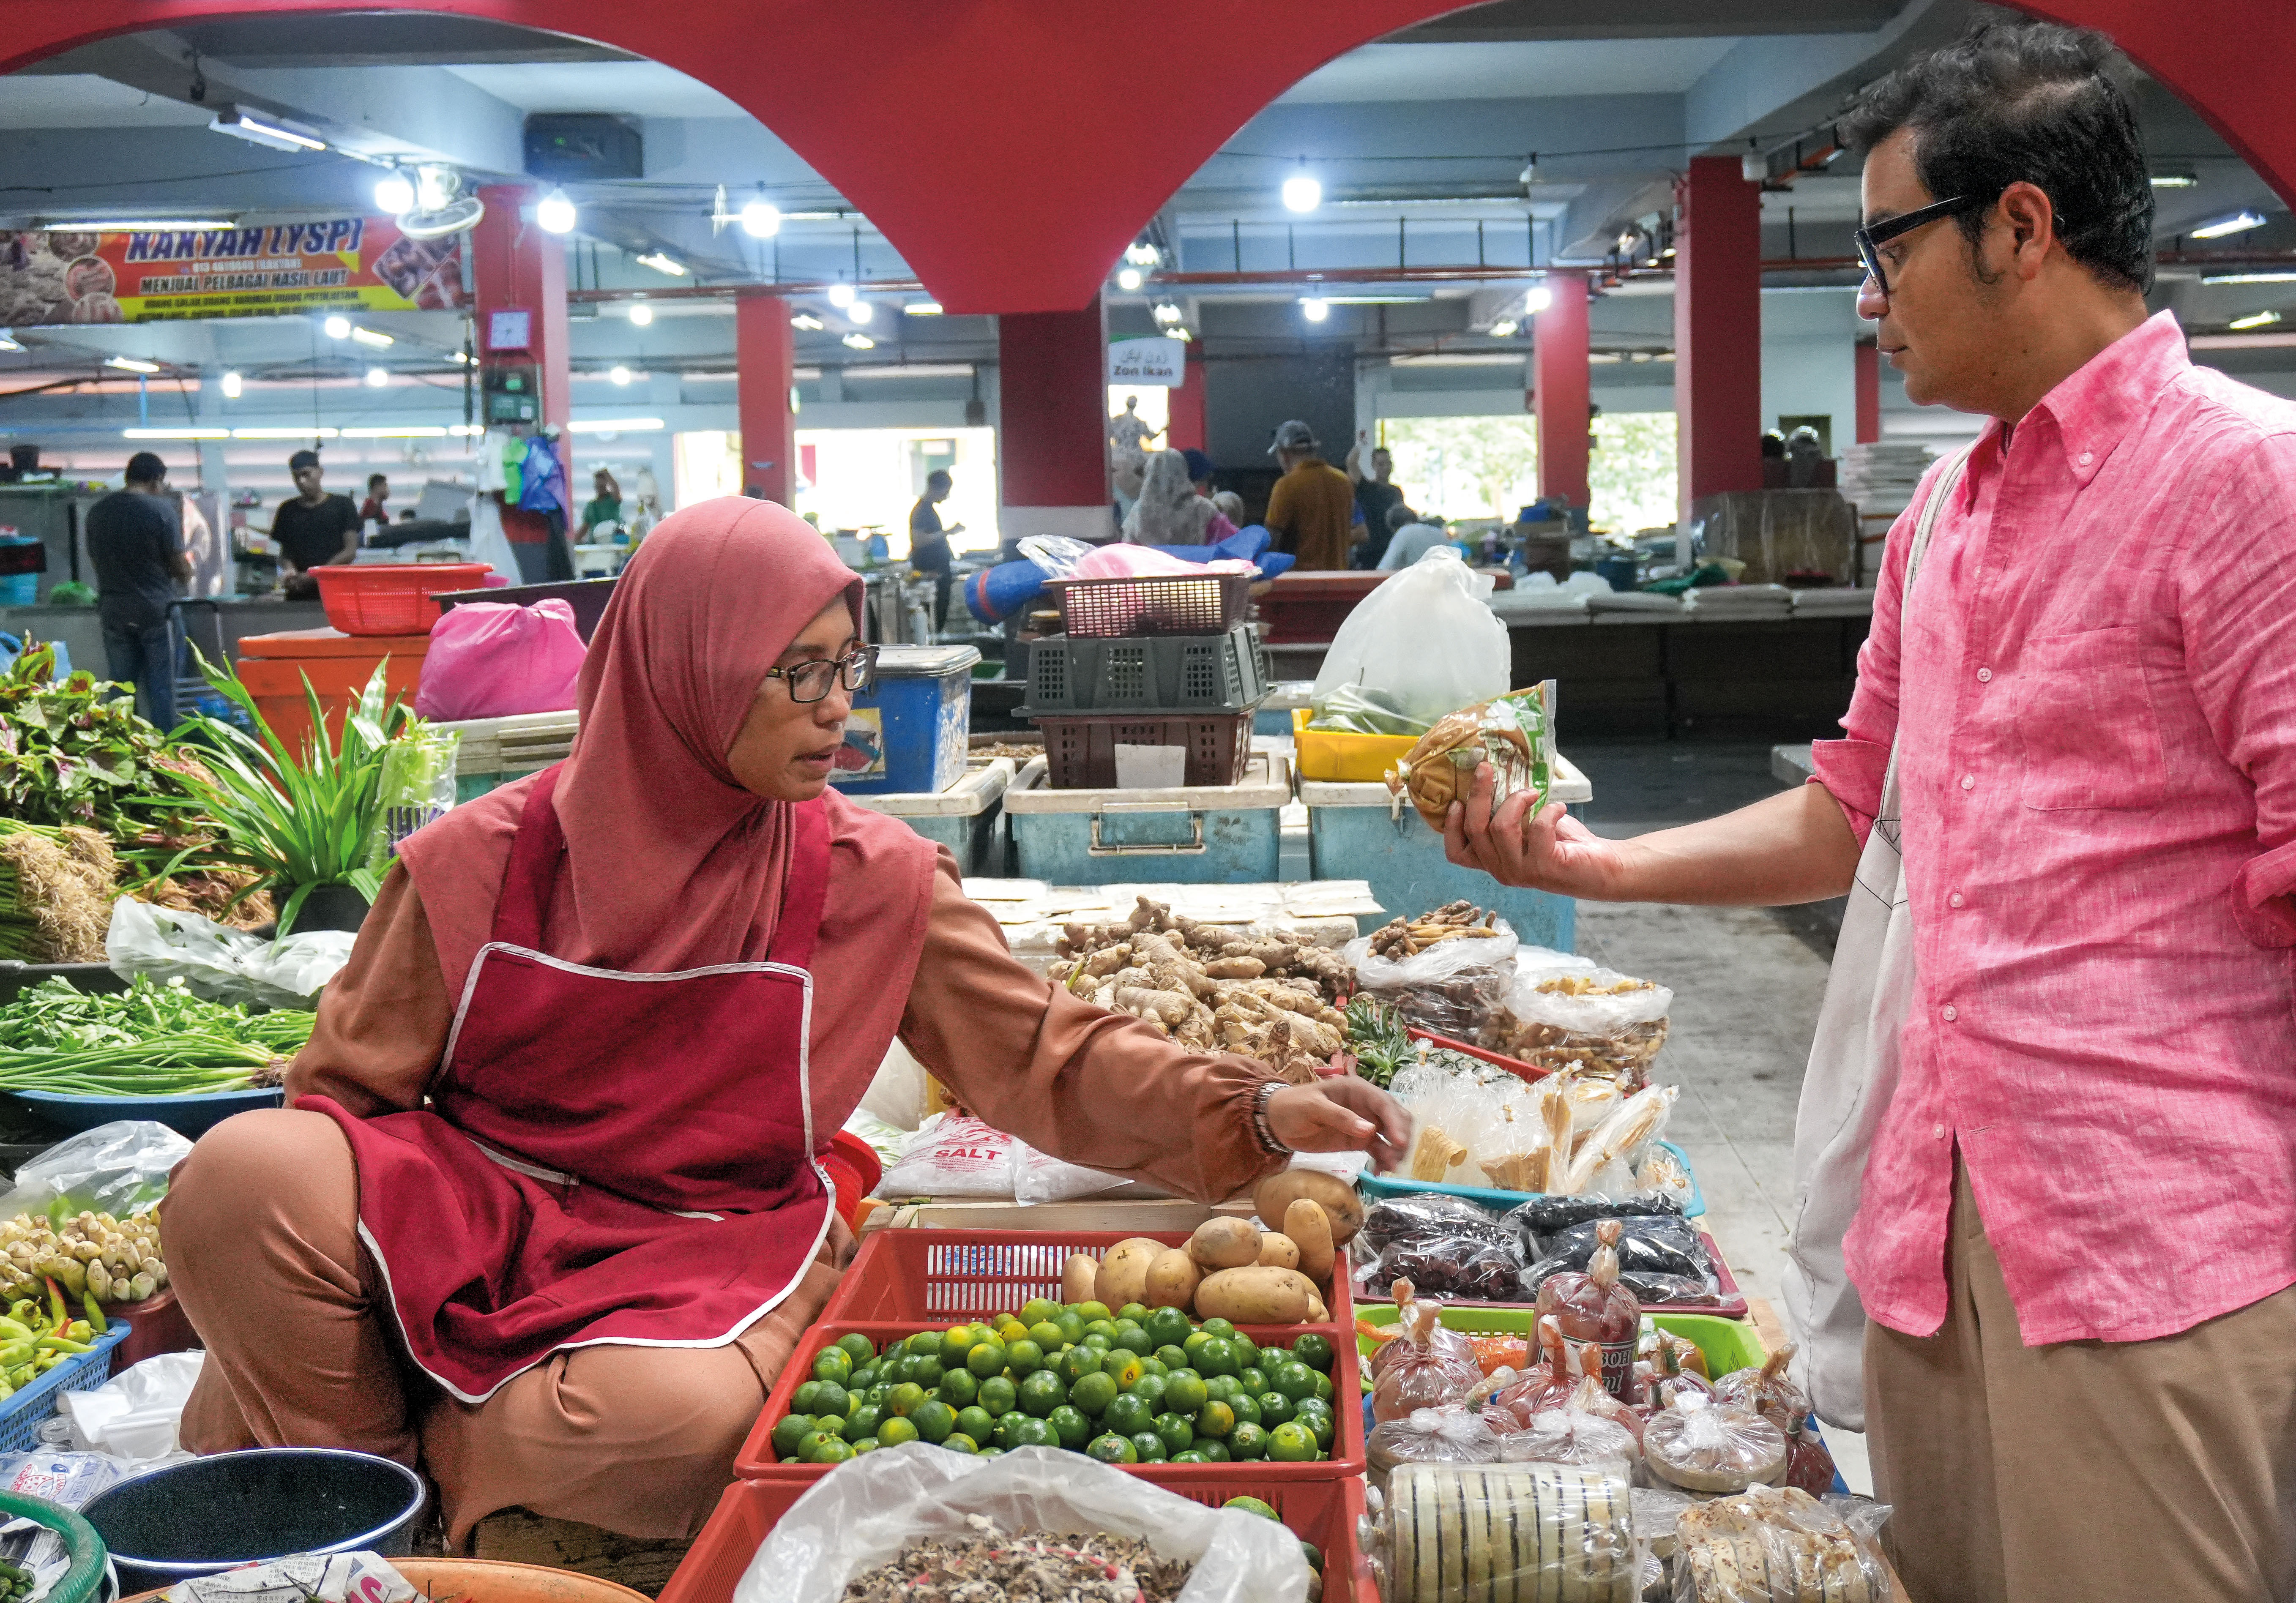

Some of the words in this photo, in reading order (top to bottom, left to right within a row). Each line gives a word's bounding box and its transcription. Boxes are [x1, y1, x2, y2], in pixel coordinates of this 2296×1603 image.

[140, 276, 200, 294] MENJUAL
[203, 273, 268, 292] PELBAGAI
[313, 268, 348, 286] LAUT
[1113, 366, 1139, 376] Zon
[1143, 365, 1173, 376] Ikan
[933, 1148, 1003, 1160] SALT
